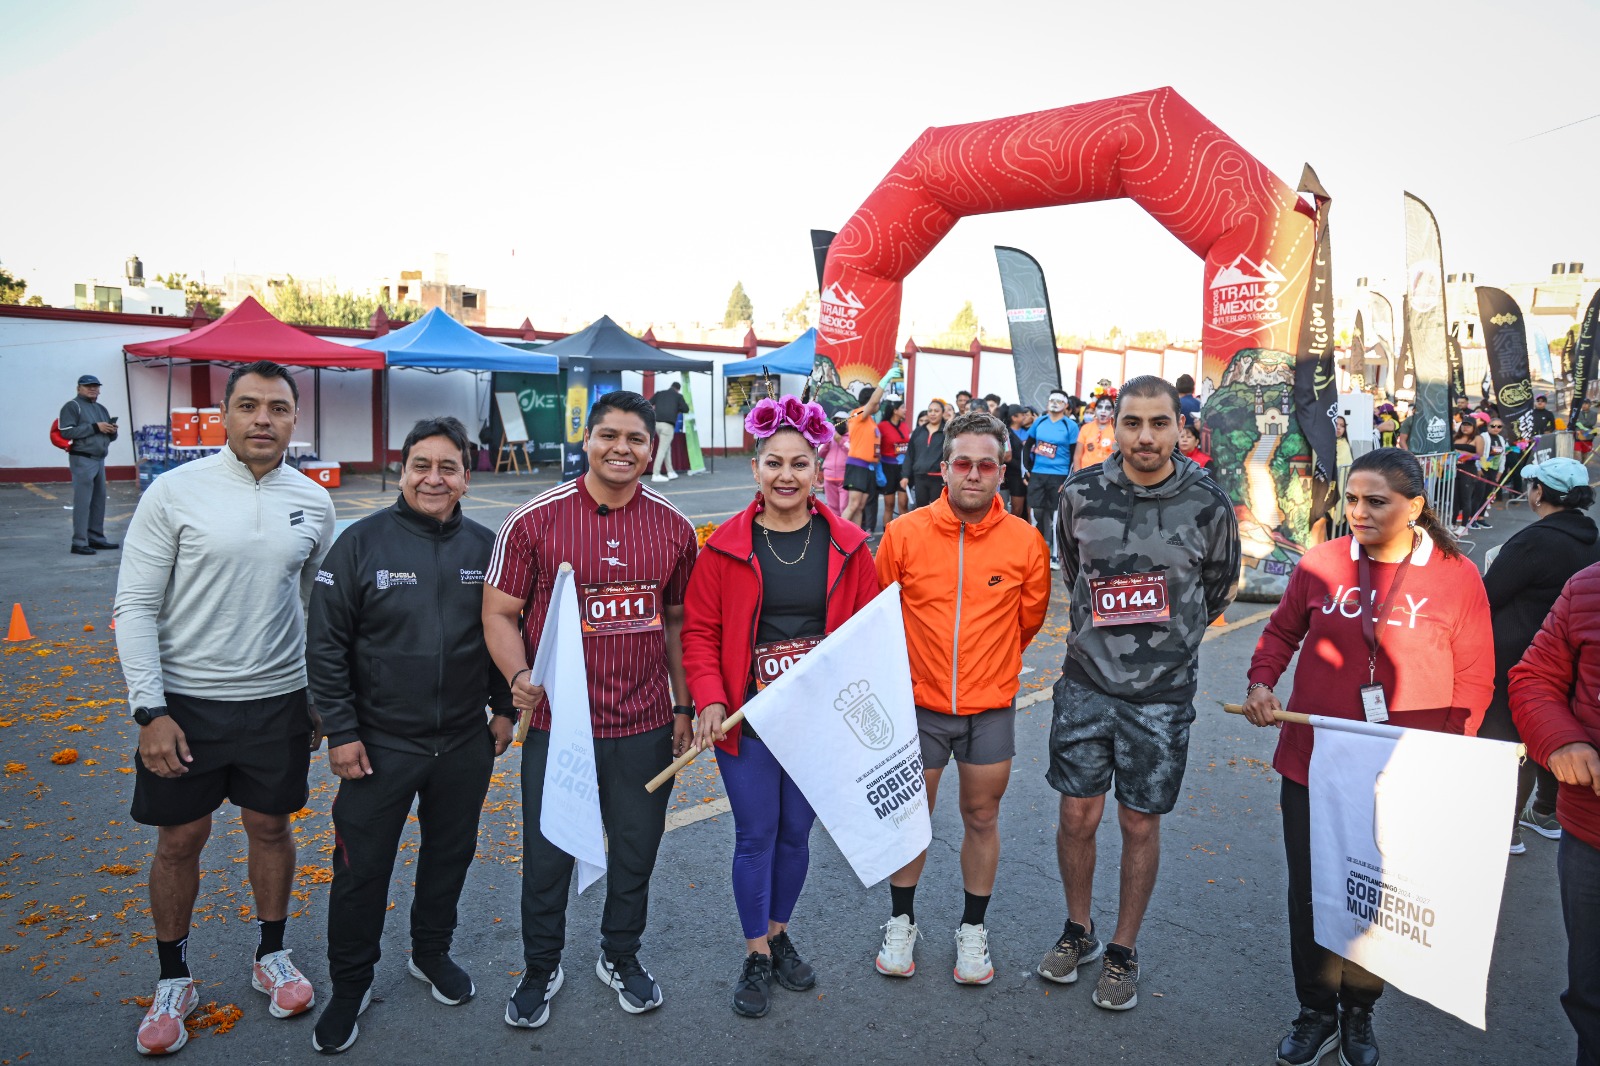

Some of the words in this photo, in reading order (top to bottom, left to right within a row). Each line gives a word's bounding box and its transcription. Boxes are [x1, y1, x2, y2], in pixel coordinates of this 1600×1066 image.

[1219, 284, 1265, 300] TRAIL
[822, 303, 848, 317] TRAIL
[319, 470, 330, 482] G
[591, 597, 645, 619] 0111
[1102, 589, 1157, 610] 0144
[765, 653, 806, 676] 00
[866, 759, 907, 790] CUAUTLANCINGO
[889, 799, 923, 829] Tradición
[1350, 870, 1397, 893] CUAUTLANCINGO
[1398, 888, 1411, 898] 2024
[1416, 895, 1431, 905] 2027
[1346, 877, 1435, 928] GOBIERNO
[1346, 896, 1432, 948] MUNICIPAL
